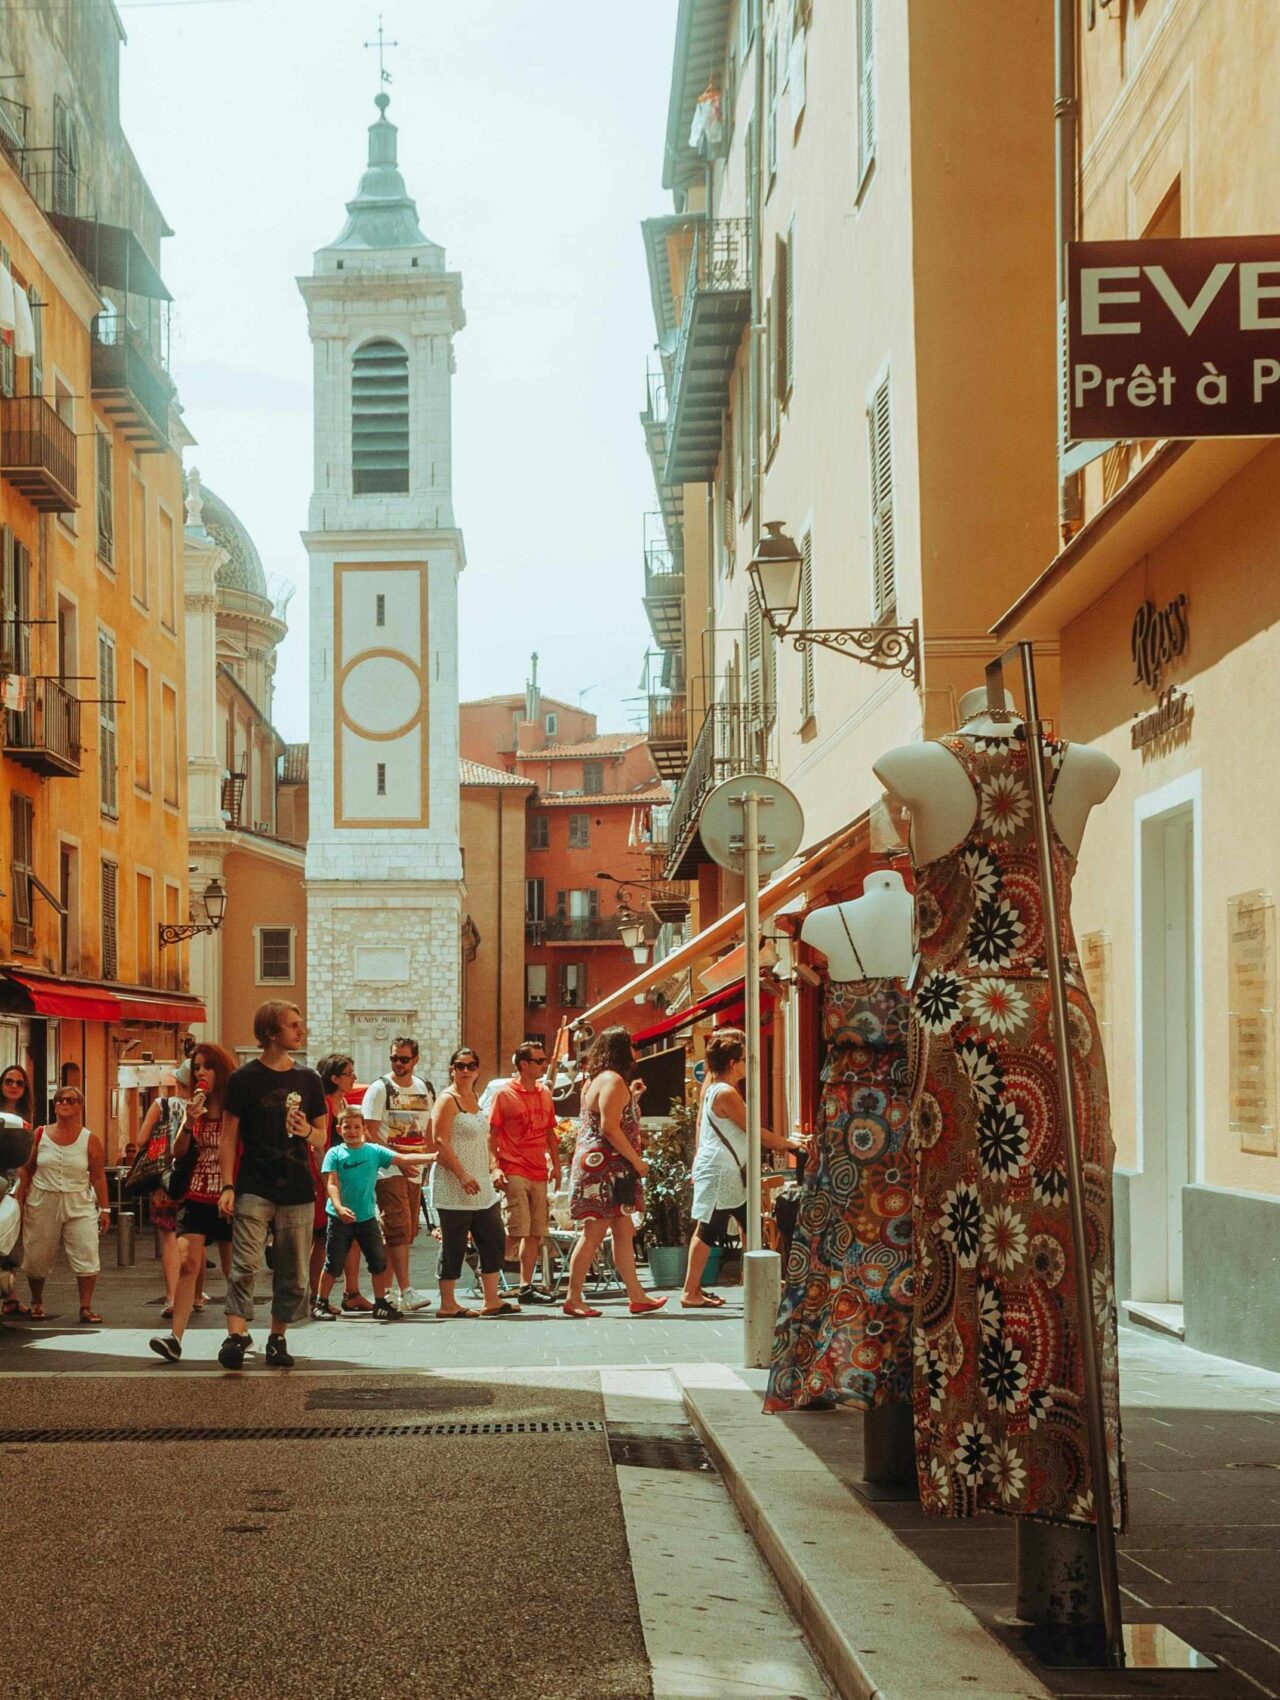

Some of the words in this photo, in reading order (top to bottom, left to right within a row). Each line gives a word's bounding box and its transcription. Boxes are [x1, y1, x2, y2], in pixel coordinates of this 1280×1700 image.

[1075, 363, 1176, 408] Prêt
[1195, 362, 1227, 405] à
[364, 1016, 379, 1024] NOS
